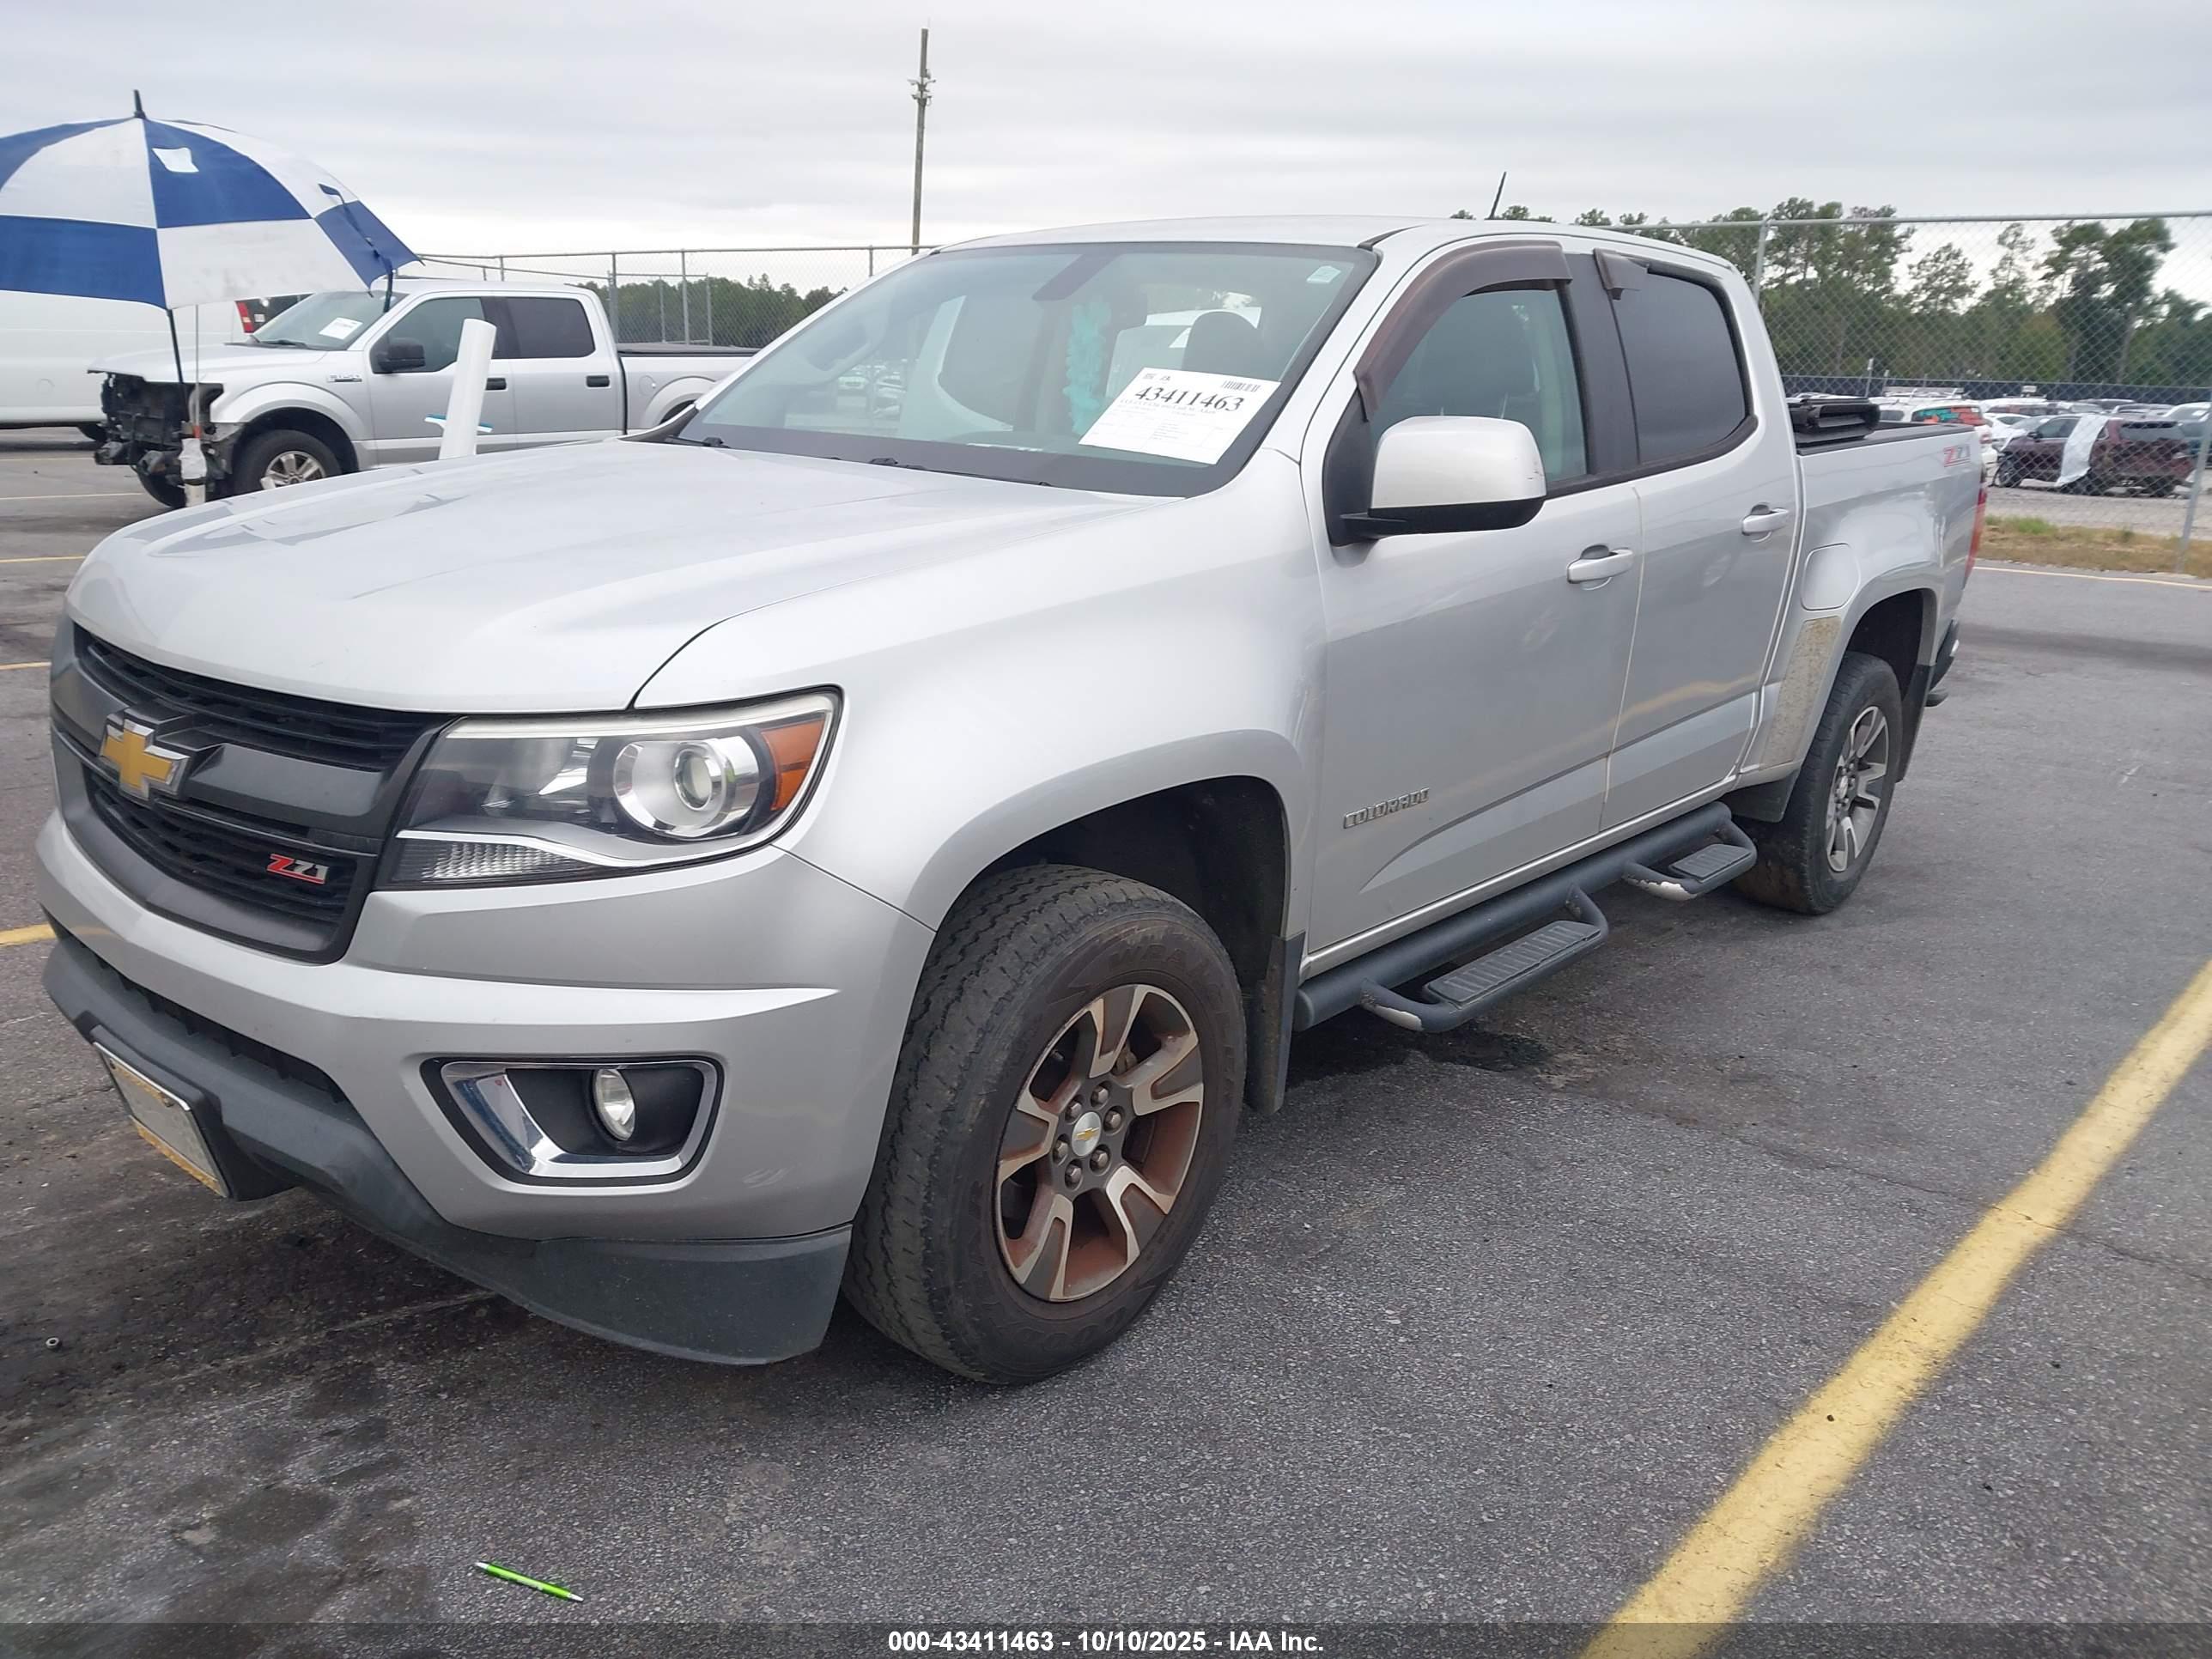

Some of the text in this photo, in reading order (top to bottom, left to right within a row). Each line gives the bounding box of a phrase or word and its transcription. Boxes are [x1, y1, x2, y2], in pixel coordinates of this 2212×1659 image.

[1135, 386, 1244, 412] 43411463
[1943, 446, 1971, 467] Z71
[1343, 787, 1430, 830] COLORADO
[266, 853, 330, 884] Z71
